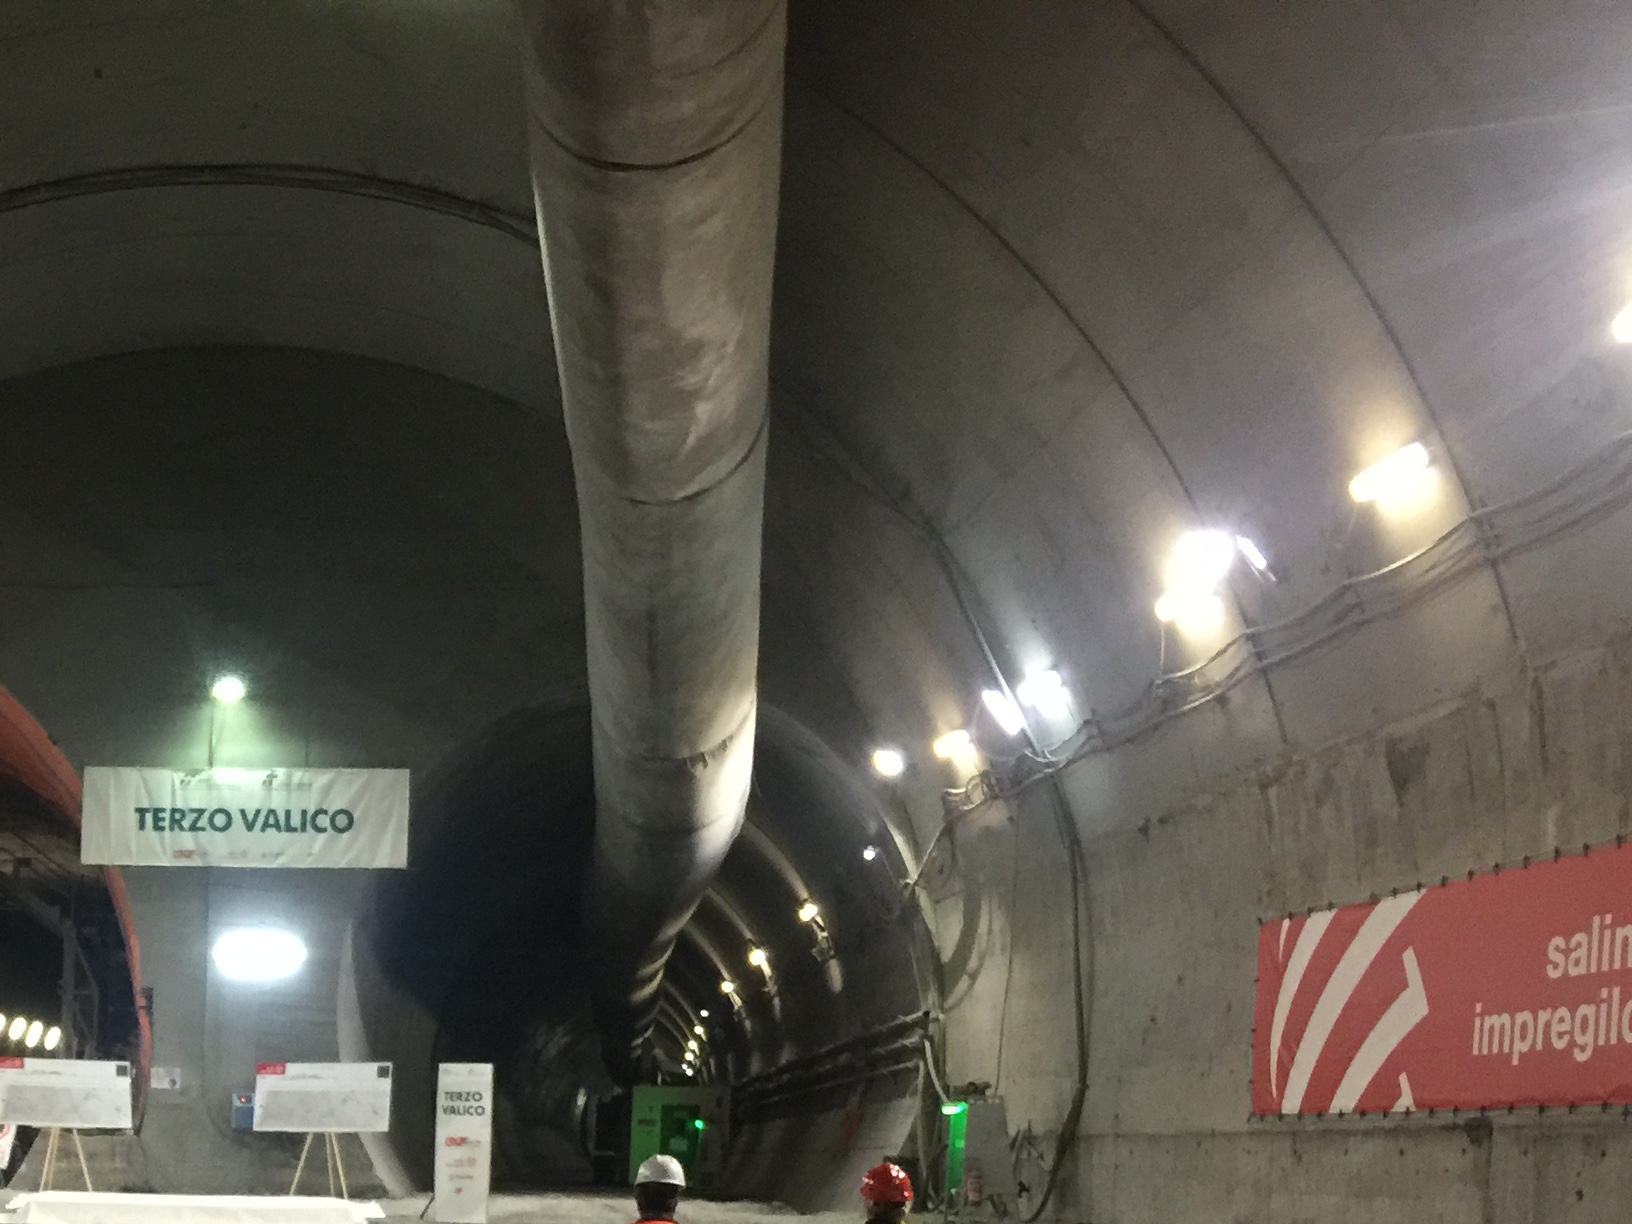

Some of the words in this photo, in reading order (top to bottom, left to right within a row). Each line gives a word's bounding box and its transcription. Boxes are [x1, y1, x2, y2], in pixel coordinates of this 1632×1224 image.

[134, 806, 233, 832] TERZO
[239, 807, 355, 833] VALICO
[443, 1091, 484, 1103] TERZO
[441, 1105, 486, 1117] VALICO
